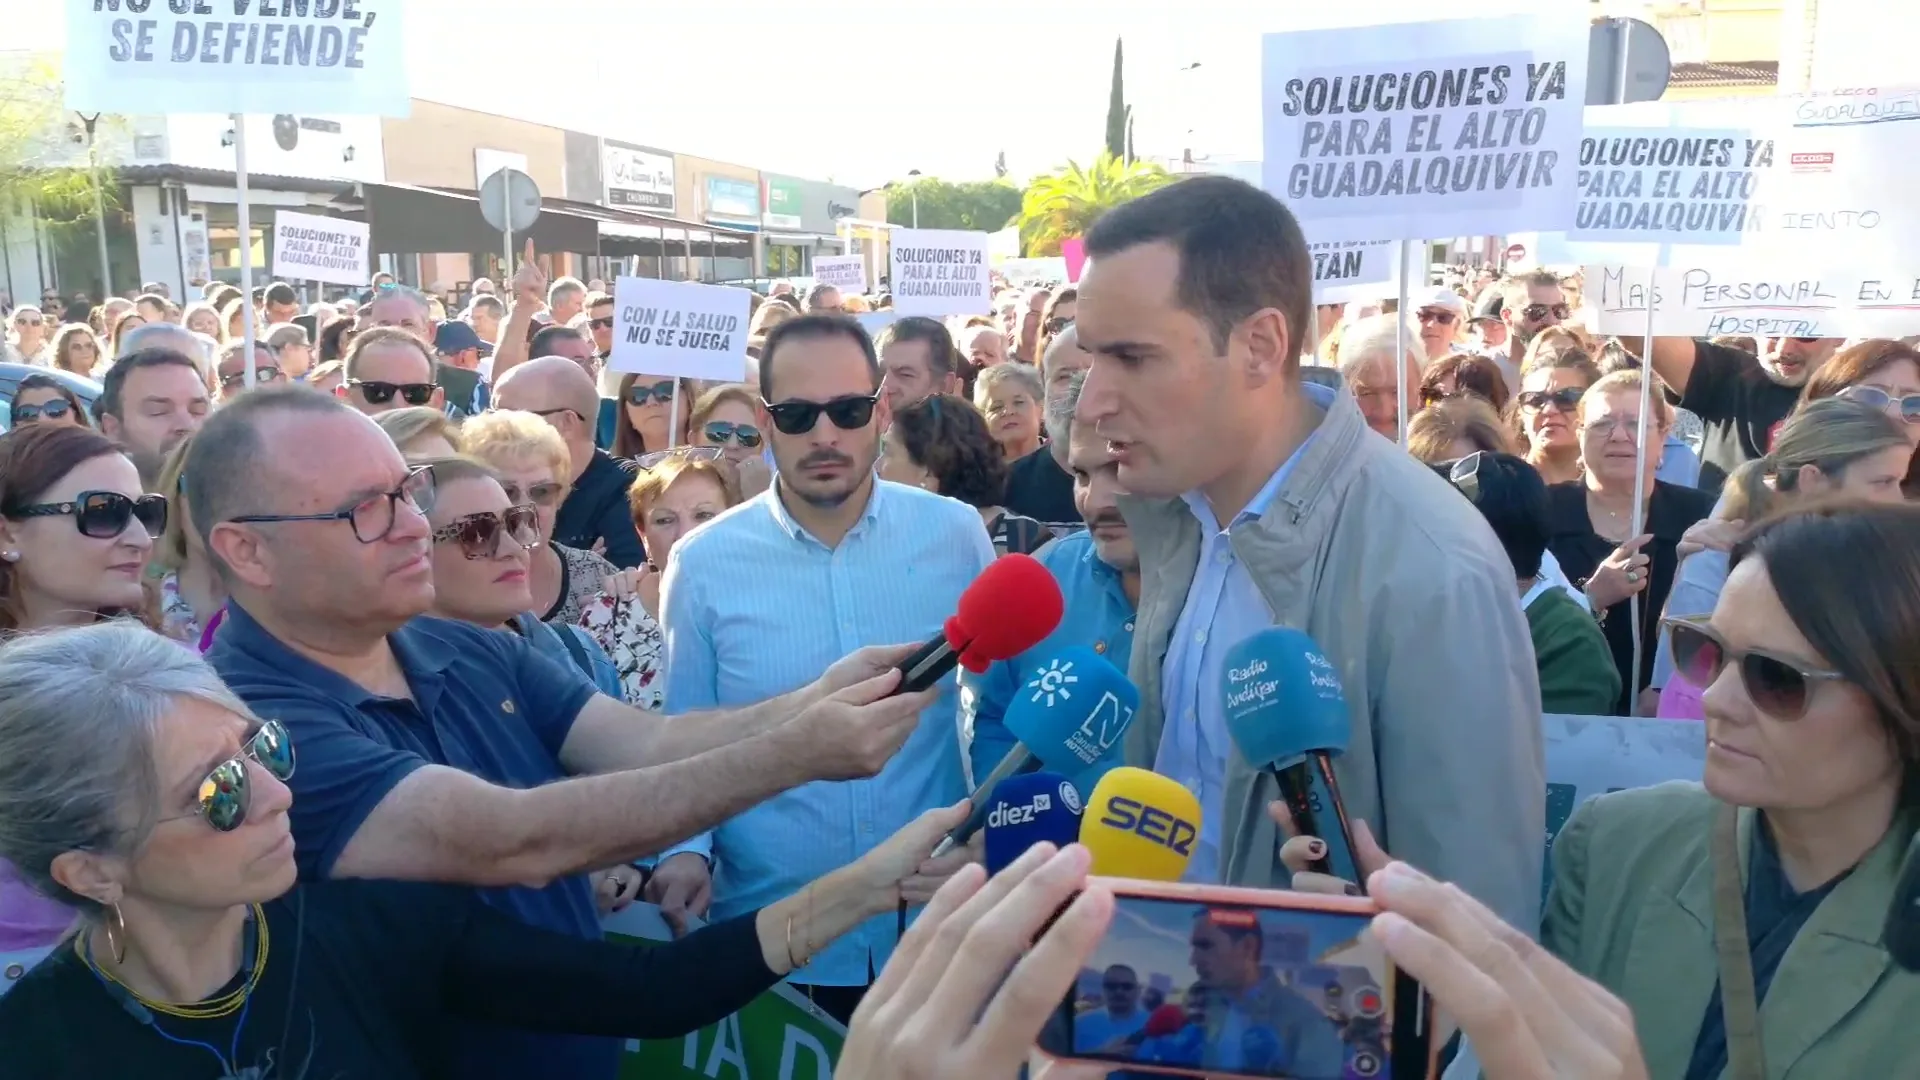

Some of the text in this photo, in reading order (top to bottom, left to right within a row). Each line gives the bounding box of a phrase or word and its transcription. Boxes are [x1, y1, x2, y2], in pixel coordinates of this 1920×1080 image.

[109, 19, 369, 69] SE DEFIENDE
[1282, 61, 1566, 117] SOLUCIONES YA
[1300, 107, 1547, 158] PARA EL ALTO
[1579, 138, 1774, 167] OLUCIONES YA
[1287, 150, 1558, 199] GUADALQUIVIR
[1577, 170, 1758, 199] PARA EL ALTO
[1575, 202, 1766, 232] UADALQUIVIR
[1782, 210, 1881, 230] IENTO
[280, 225, 361, 247] SOLUCIONES YA
[286, 240, 356, 259] PARA EL ALTO
[281, 251, 360, 271] GUADALQUIVIR
[896, 247, 982, 265] SOLUCIONES YA
[1314, 251, 1363, 280] TAN
[903, 265, 977, 281] PARA EL ALTO
[1682, 268, 1837, 306] PERSONAL
[1858, 280, 1893, 300] EN
[899, 282, 982, 298] GUADALQUIVIR
[623, 305, 738, 333] CON LA SALUD
[1705, 314, 1824, 337] HOSPITAL
[626, 326, 730, 351] NO SE JUEGA
[1228, 659, 1268, 684] Radio
[988, 801, 1034, 828] diez
[1100, 795, 1197, 858] SER
[778, 1023, 834, 1080] D
